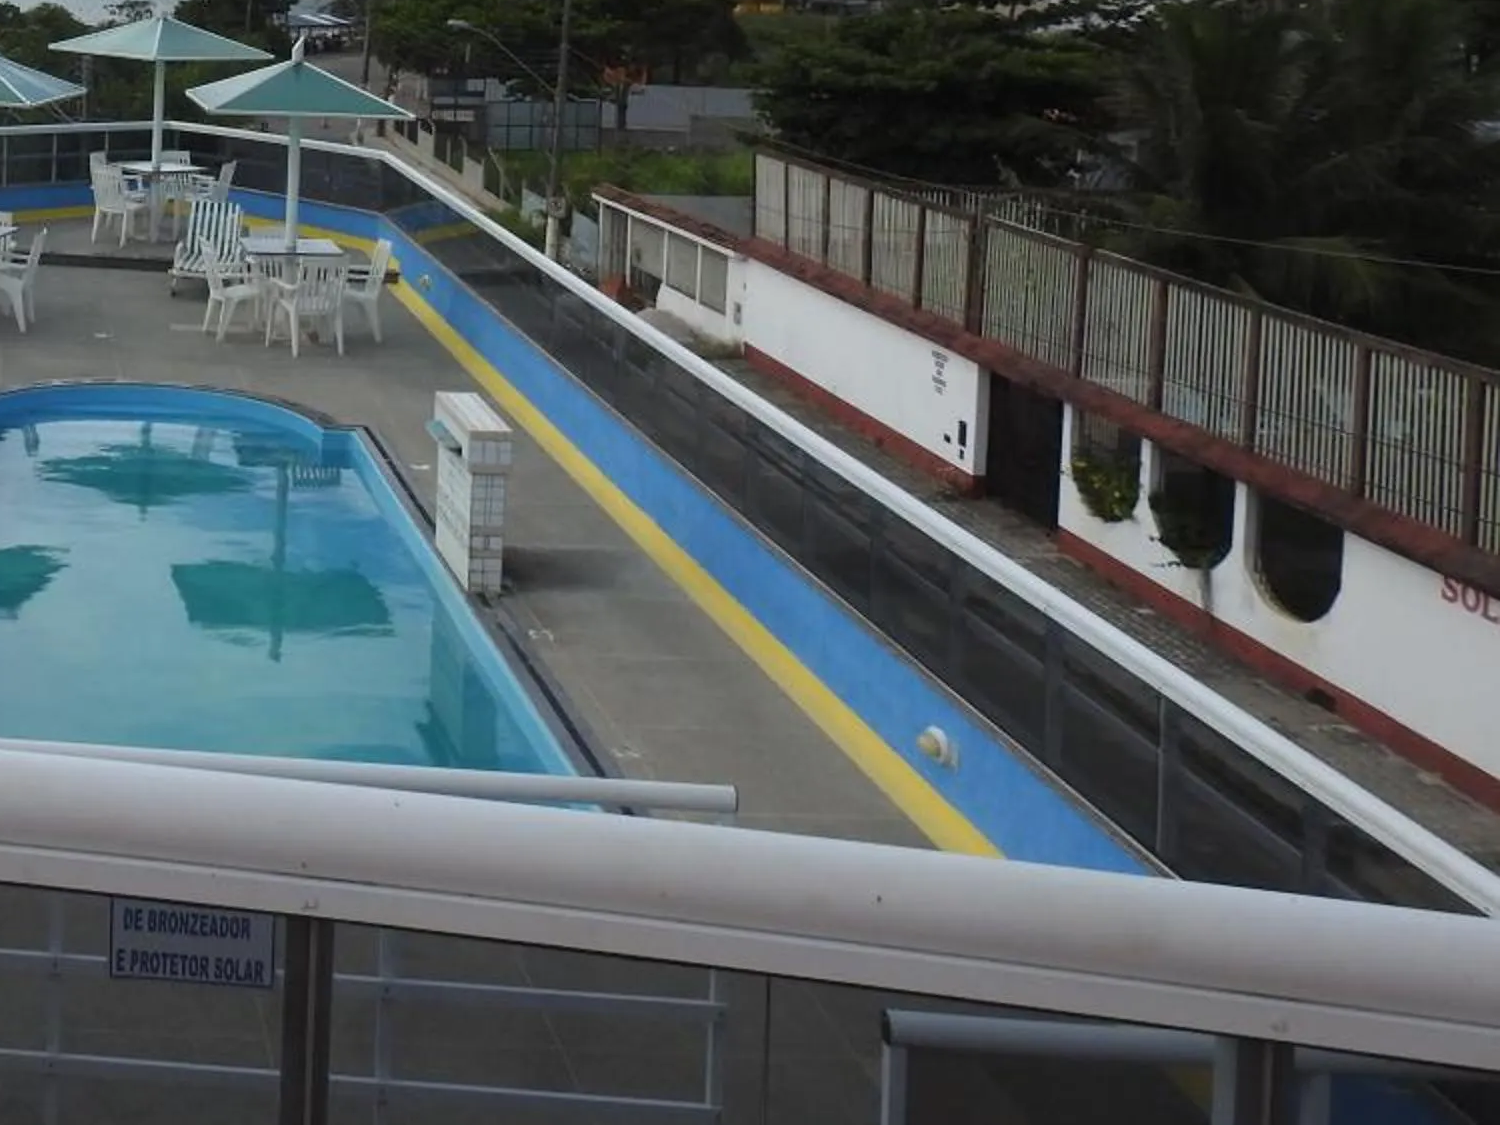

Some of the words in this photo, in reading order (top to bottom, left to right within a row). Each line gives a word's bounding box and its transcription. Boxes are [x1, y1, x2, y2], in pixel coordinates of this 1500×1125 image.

[124, 907, 143, 931] DE
[148, 909, 251, 941] BRONZEADOR
[116, 948, 126, 971] E
[131, 950, 209, 979] PROTETOR
[214, 957, 264, 983] SOLAR
